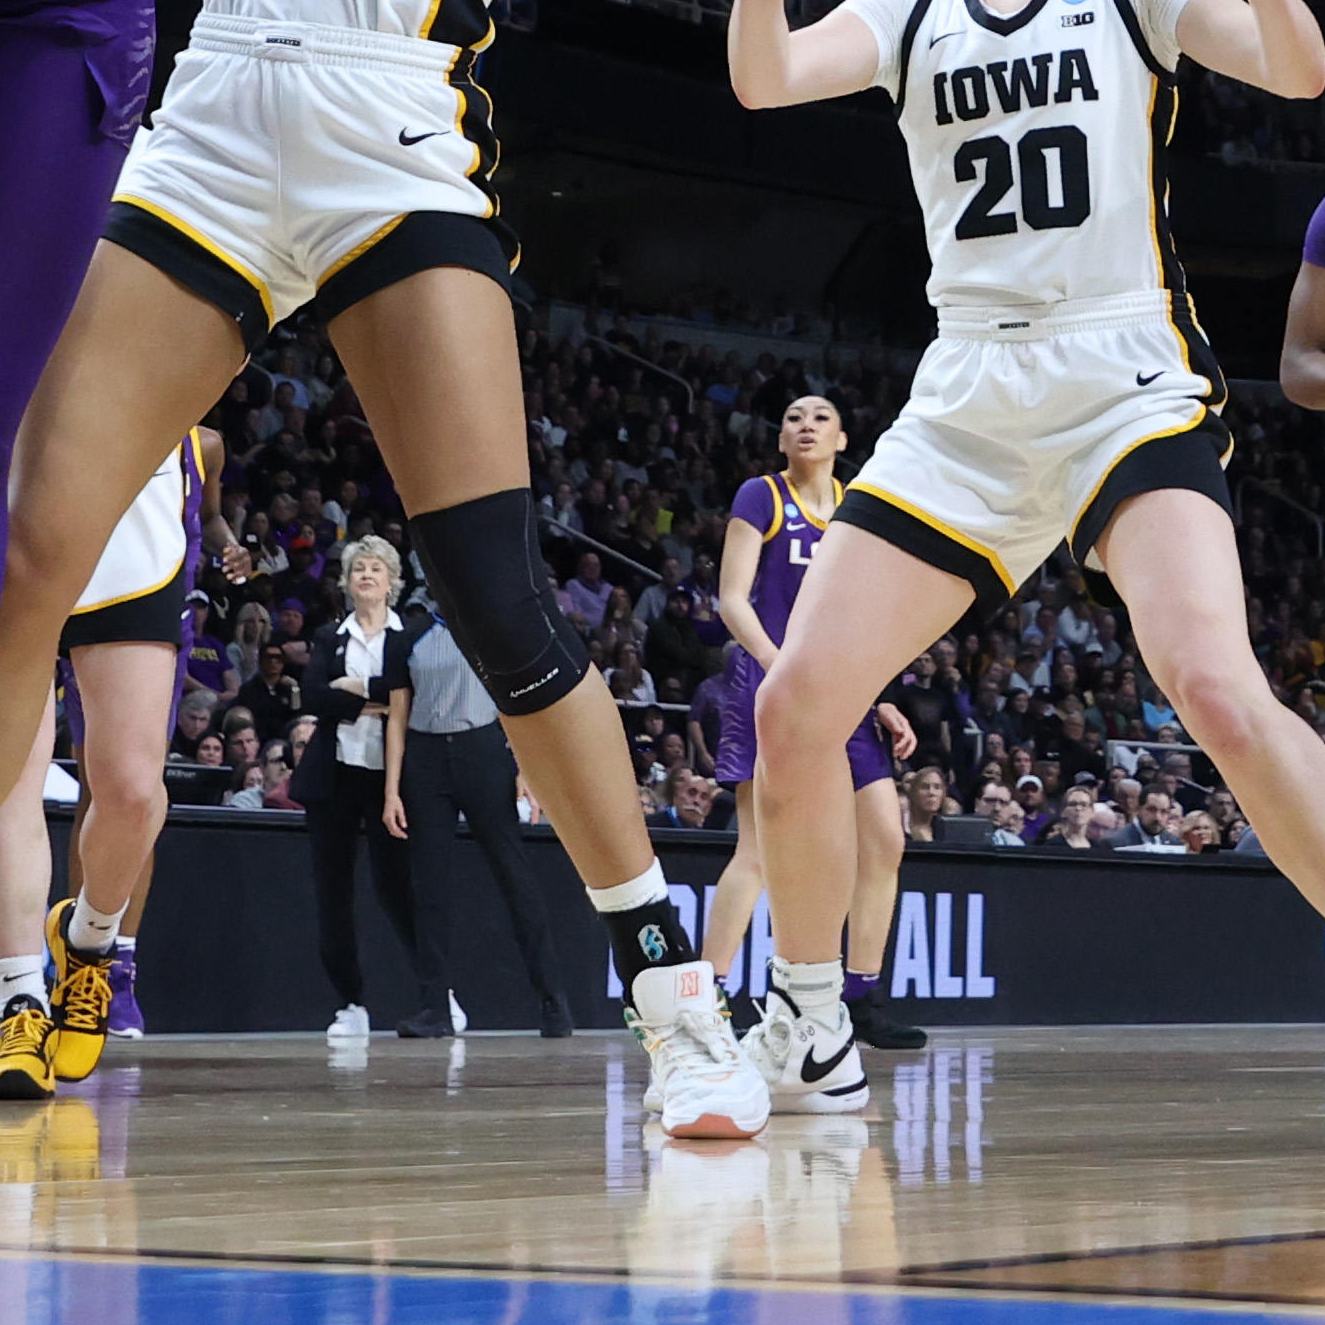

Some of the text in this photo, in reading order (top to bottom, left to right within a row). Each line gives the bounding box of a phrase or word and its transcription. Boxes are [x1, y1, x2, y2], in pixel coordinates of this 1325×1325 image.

[933, 48, 1100, 126] IOWA
[953, 124, 1091, 241] 20
[890, 890, 996, 999] ALL
